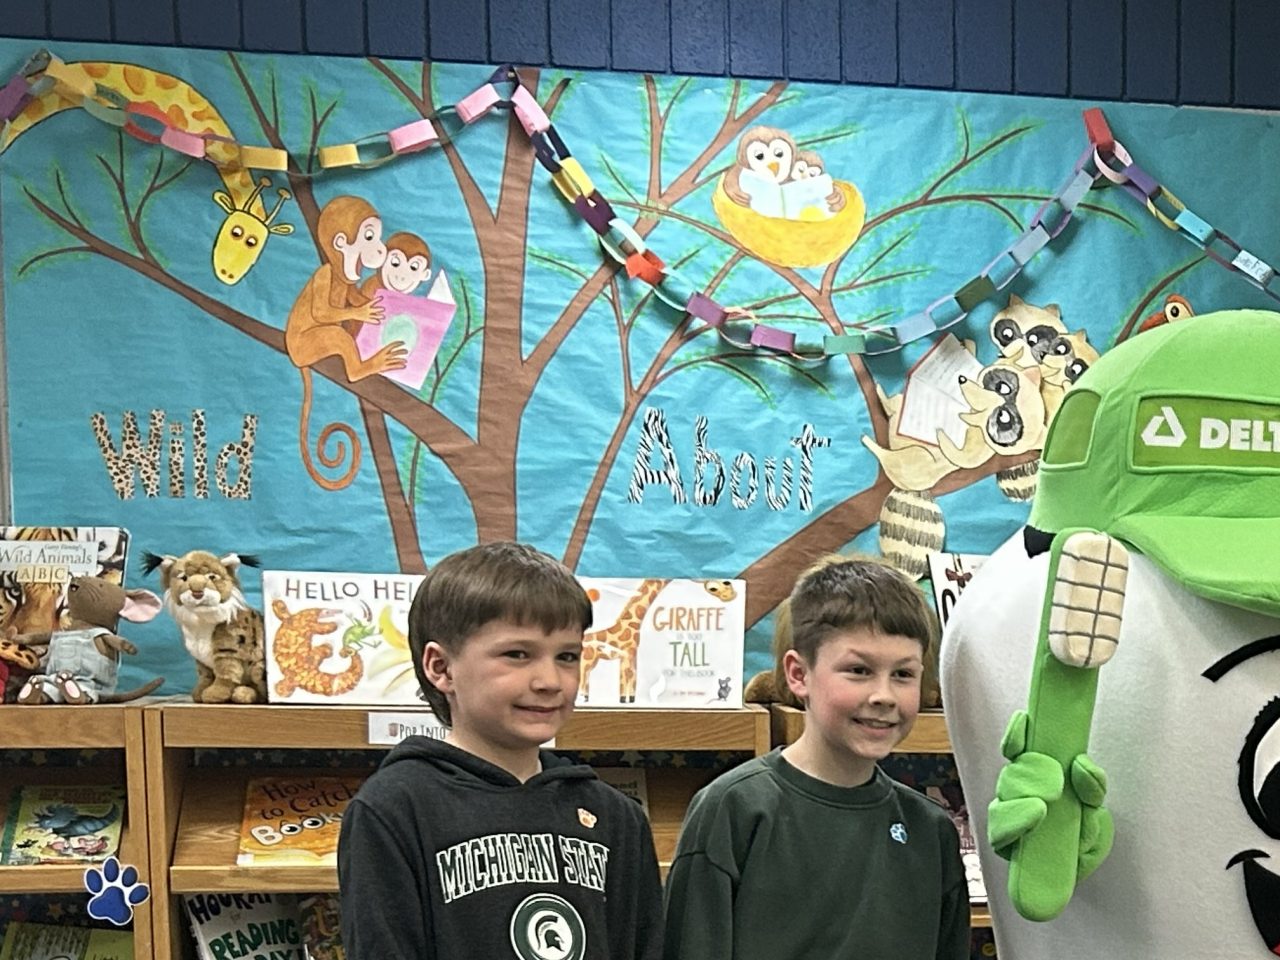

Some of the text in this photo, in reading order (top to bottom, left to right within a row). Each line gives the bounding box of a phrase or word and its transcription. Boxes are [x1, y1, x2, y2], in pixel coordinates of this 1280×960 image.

[90, 406, 832, 512] Wild About
[34, 547, 92, 565] Animals
[285, 578, 359, 601] HELLO
[653, 606, 727, 632] GIRAFFE
[669, 641, 711, 667] TALL
[262, 780, 316, 802] How
[261, 808, 284, 820] to
[436, 833, 610, 903] MICHIGAN STAT
